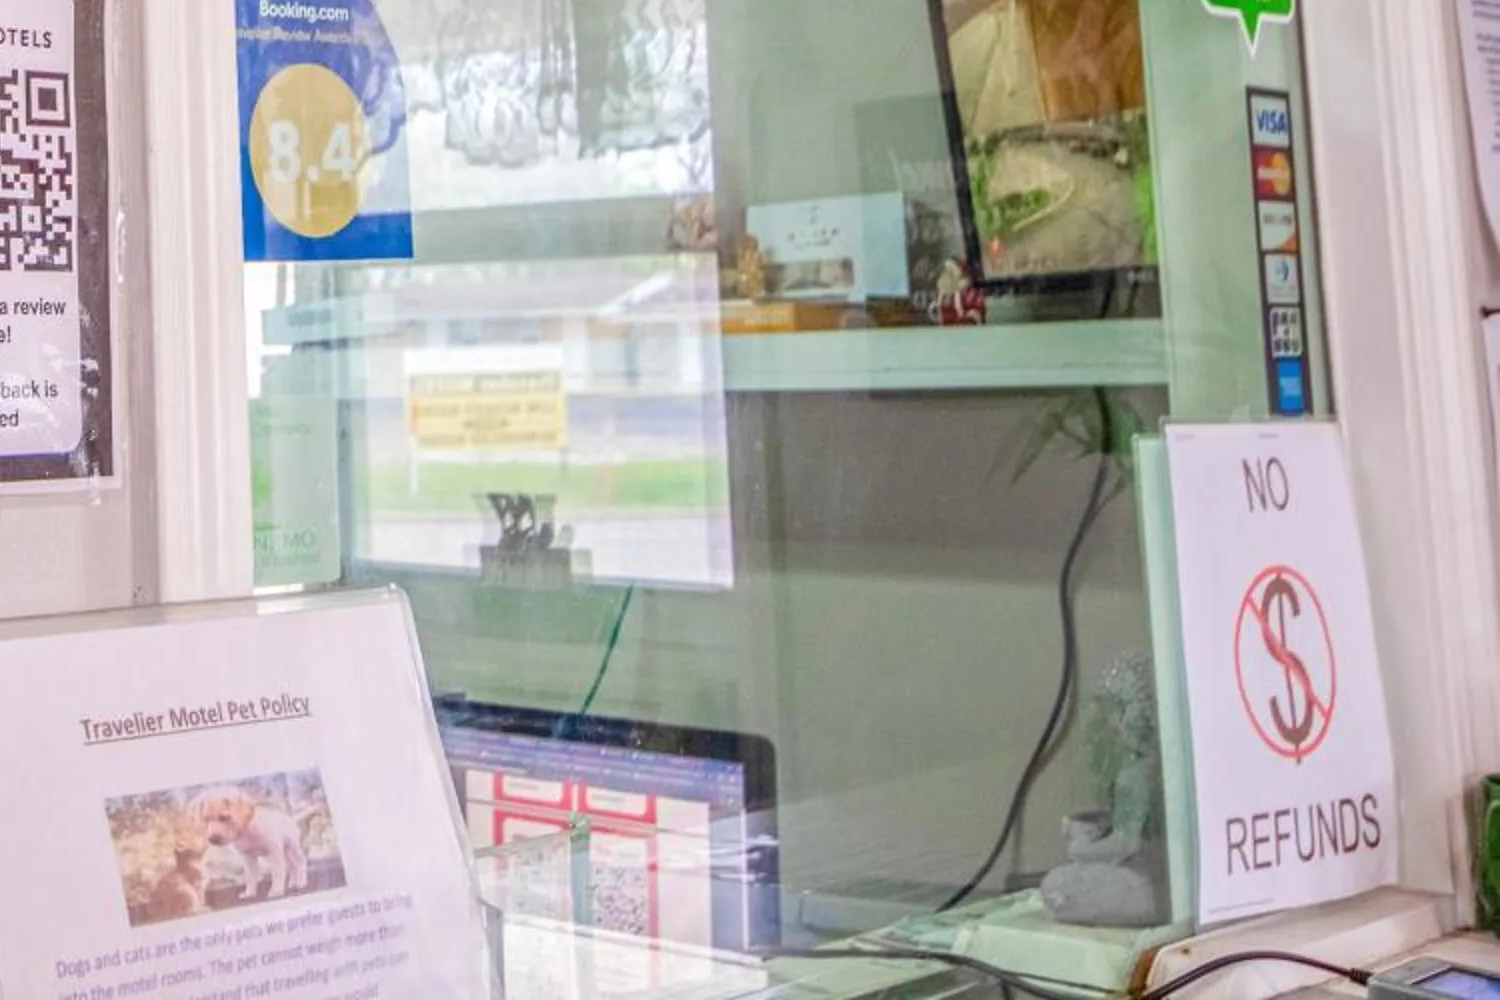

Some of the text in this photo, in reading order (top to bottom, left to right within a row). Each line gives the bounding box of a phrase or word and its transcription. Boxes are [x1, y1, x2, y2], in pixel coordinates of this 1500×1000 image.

[259, 0, 349, 22] Booking.com
[1256, 110, 1288, 134] VISA
[269, 119, 357, 184] 8.4
[12, 297, 67, 316] review
[44, 380, 59, 399] is
[1242, 456, 1290, 513] NO
[79, 693, 311, 741] Travelier Motel Pet Policy
[1225, 793, 1382, 876] REFUNDS
[55, 958, 91, 979] Dogs
[94, 949, 121, 969] and
[125, 944, 151, 963] cats
[155, 941, 176, 958] are
[179, 936, 202, 954] the
[205, 927, 232, 948] only
[266, 919, 284, 935] we
[287, 910, 324, 933] prefer
[90, 982, 115, 1000] the
[118, 975, 157, 997] motel
[209, 958, 233, 975] The
[237, 953, 258, 972] pet
[261, 943, 303, 967] cannot
